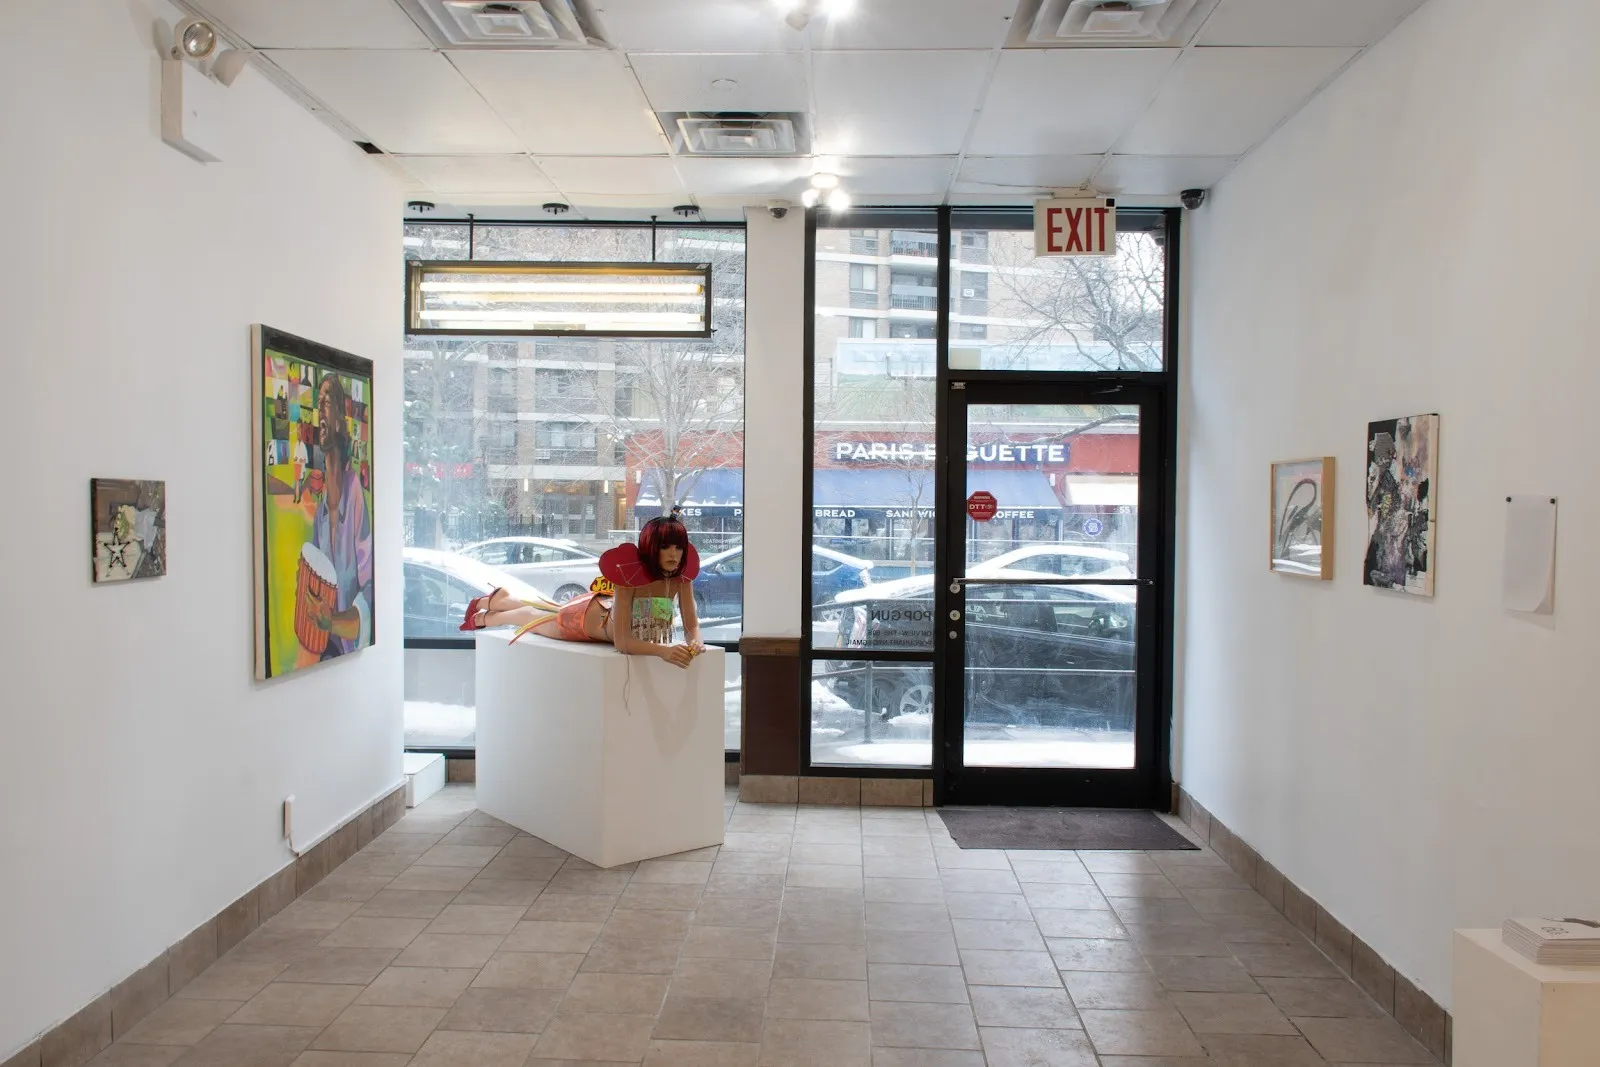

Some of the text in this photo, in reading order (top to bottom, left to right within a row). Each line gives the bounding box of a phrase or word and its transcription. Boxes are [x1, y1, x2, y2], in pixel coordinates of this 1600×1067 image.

[1047, 208, 1109, 252] EXIT
[836, 443, 1065, 461] PARIS BGUETTE
[680, 508, 702, 516] KES
[815, 509, 856, 517] BREAD
[886, 510, 935, 518] SANWI
[592, 576, 615, 591] Jell
